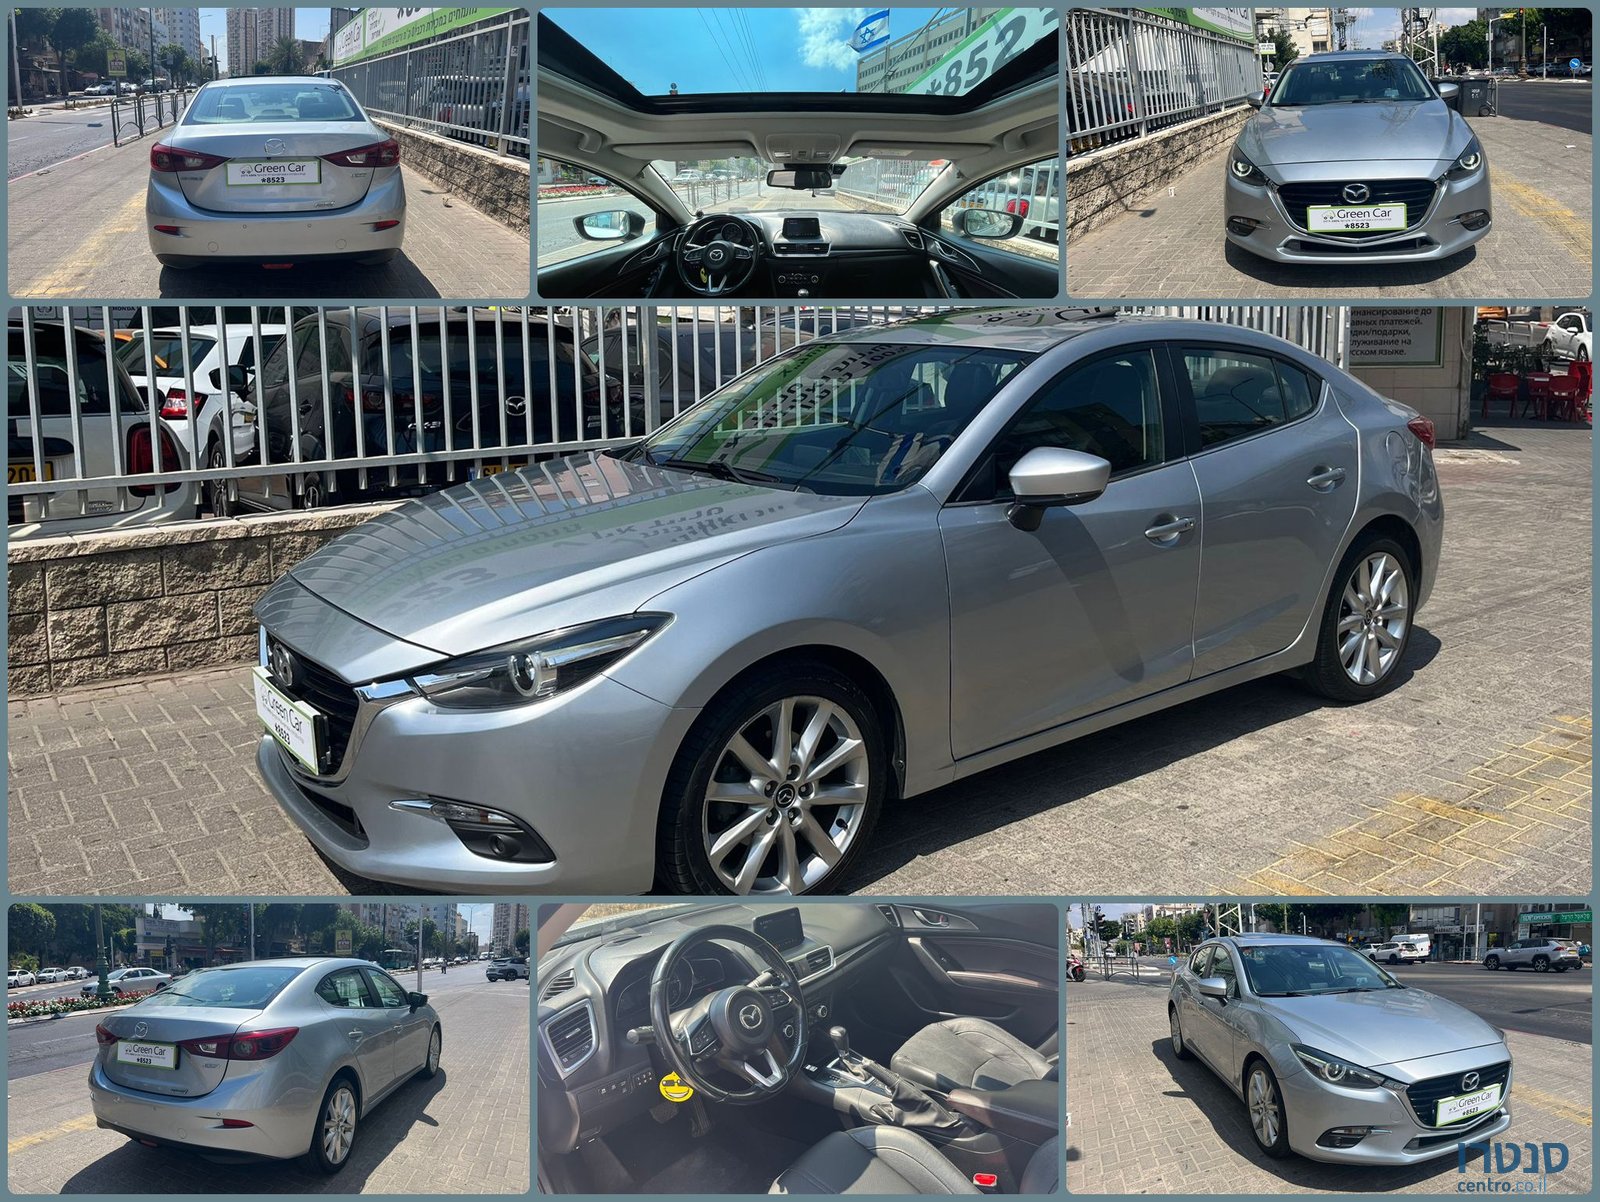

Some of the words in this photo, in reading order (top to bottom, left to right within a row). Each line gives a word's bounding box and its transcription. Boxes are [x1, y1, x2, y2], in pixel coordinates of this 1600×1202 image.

[254, 163, 286, 174] Green
[287, 162, 306, 173] Car
[1336, 209, 1371, 219] Green
[1372, 208, 1392, 218] Car
[1420, 308, 1432, 316] до
[1350, 339, 1400, 348] луживание
[267, 690, 289, 722] Green
[289, 708, 303, 734] Car
[132, 1044, 153, 1056] Green
[153, 1046, 167, 1057] Car
[1458, 1094, 1481, 1108] Green
[1481, 1090, 1493, 1101] Car
